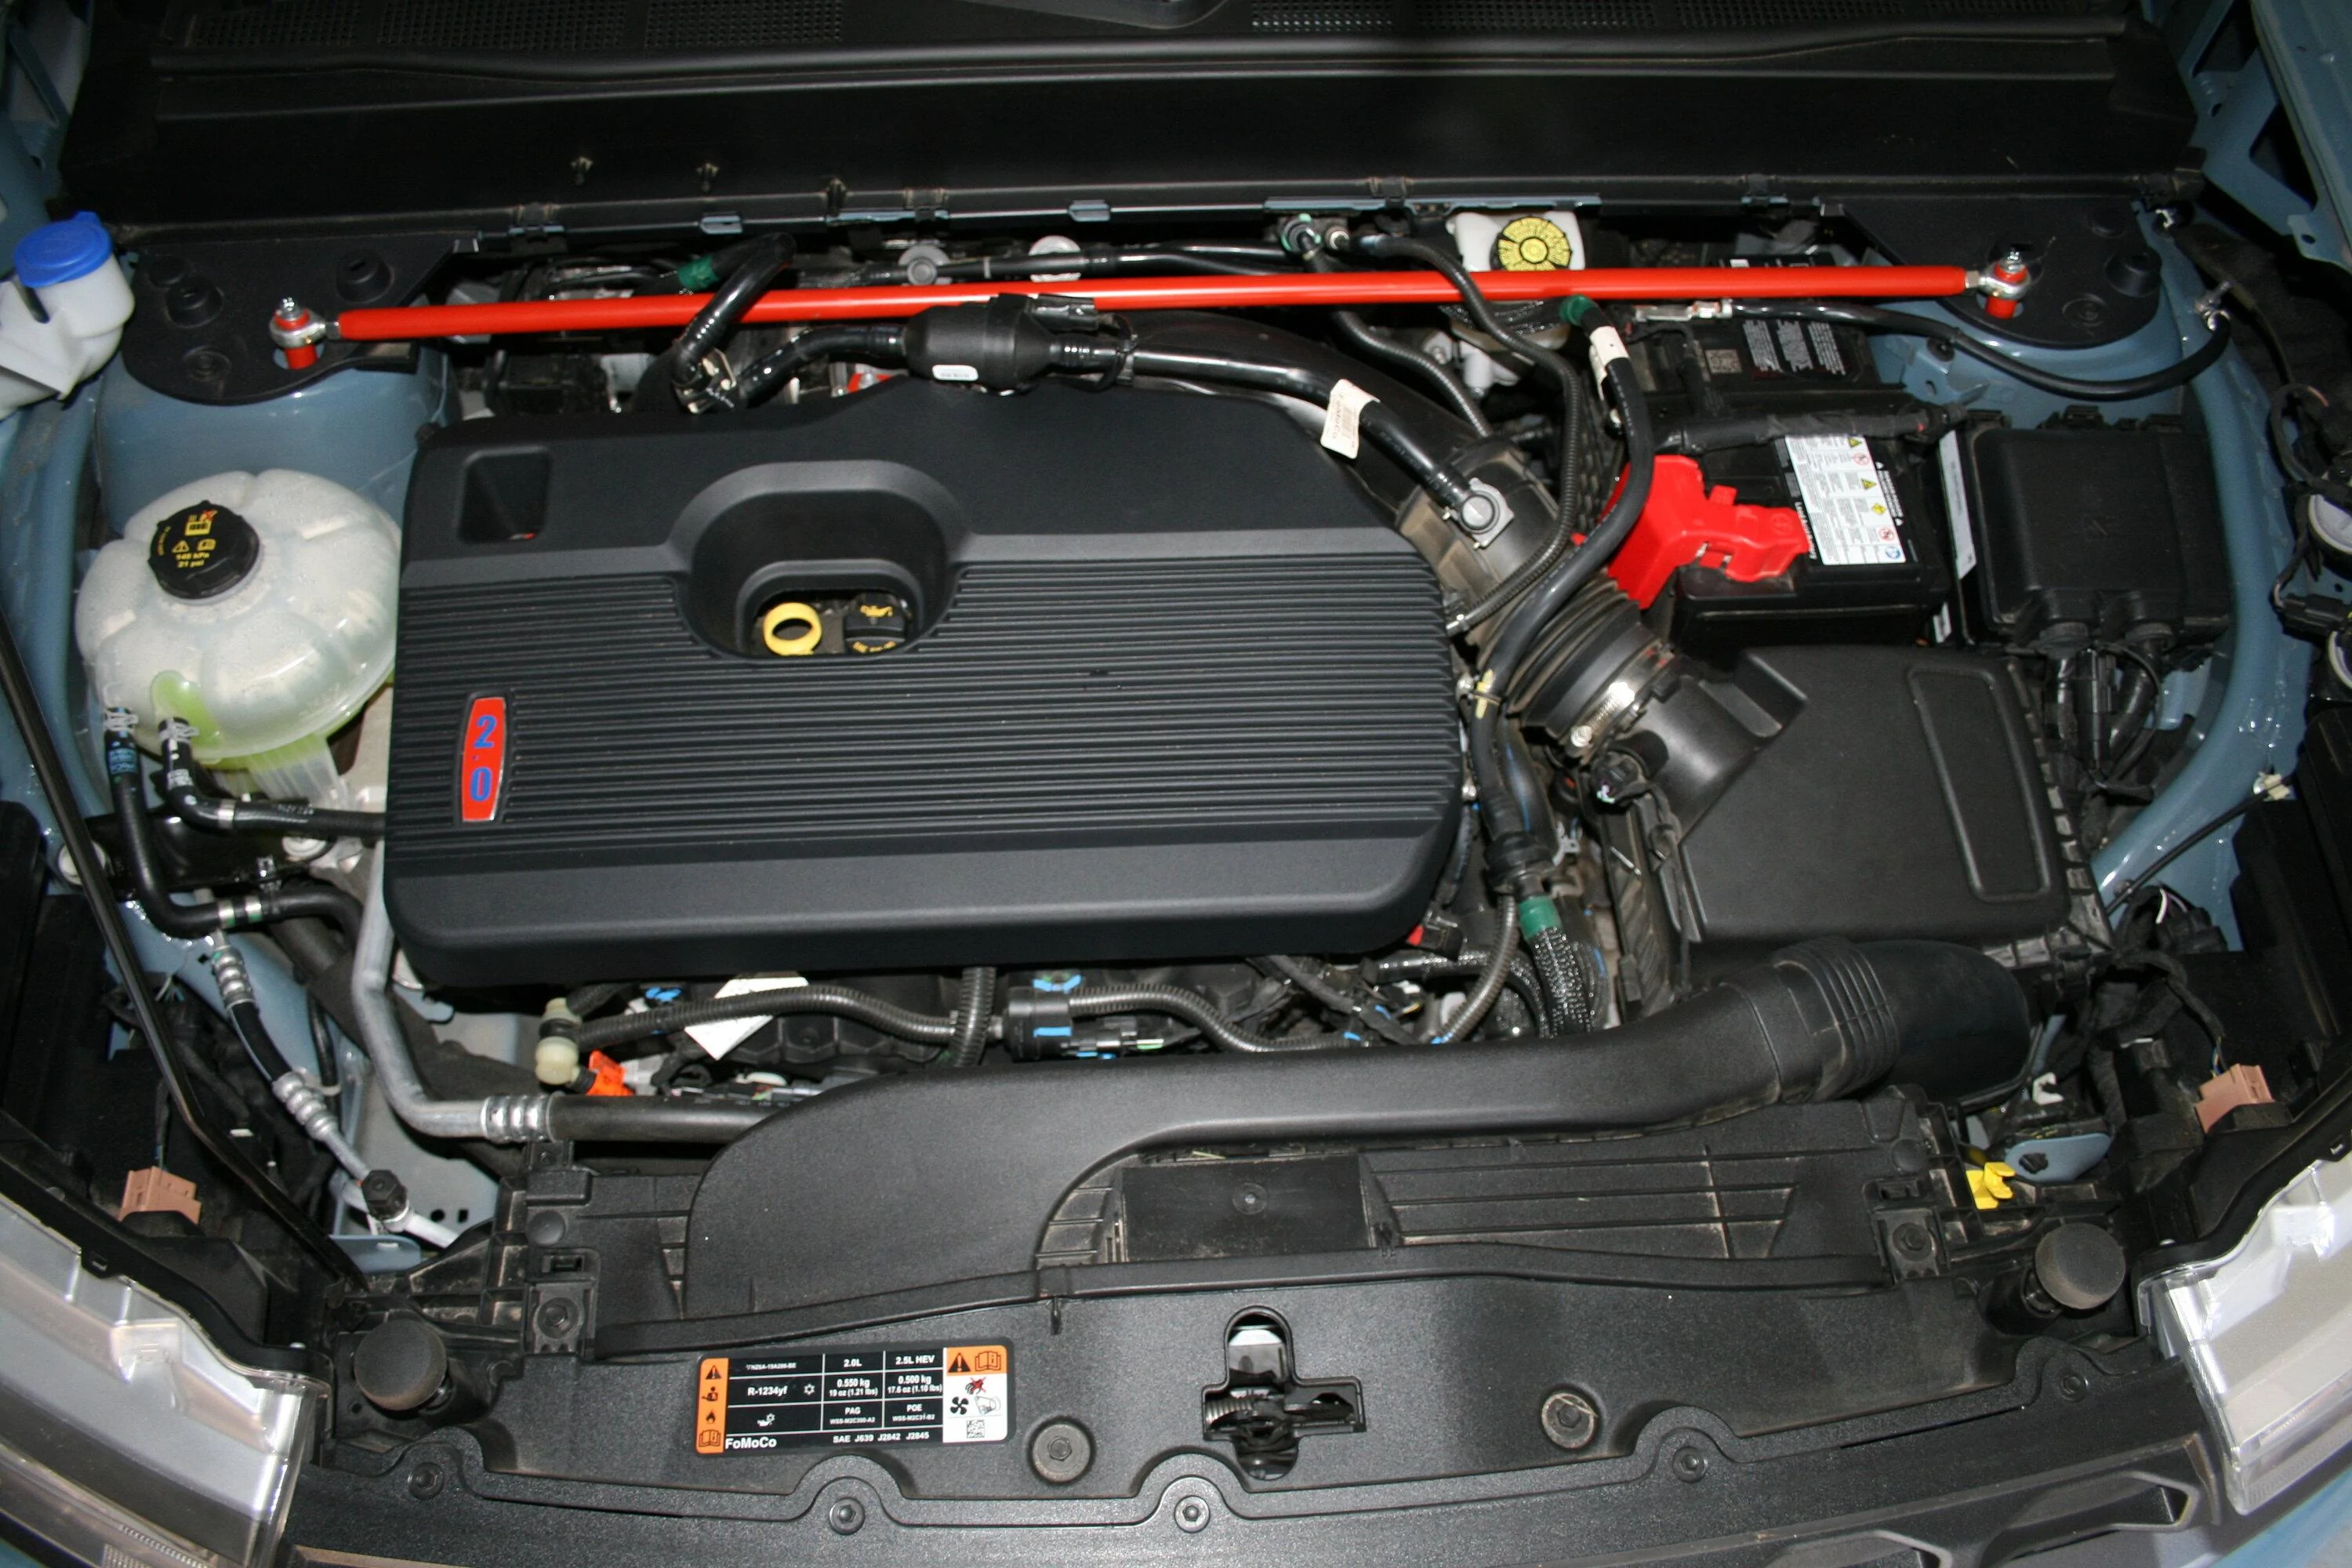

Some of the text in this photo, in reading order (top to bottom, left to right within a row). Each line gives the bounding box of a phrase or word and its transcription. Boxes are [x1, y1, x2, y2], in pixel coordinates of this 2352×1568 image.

[844, 1359, 862, 1367] 2.0L
[895, 1355, 935, 1365] 2.5L HEV
[837, 1378, 870, 1388] 0.550 kg
[898, 1374, 932, 1385] 0.500 kg
[747, 1385, 788, 1397] R-1234yf
[848, 1388, 864, 1397] (1.21
[865, 1388, 878, 1396] lbs)
[912, 1385, 928, 1394] (1.10
[929, 1385, 943, 1393] lbs)
[844, 1406, 861, 1415] PAG
[906, 1403, 923, 1412] POE
[855, 1434, 874, 1443] J639
[877, 1433, 901, 1442] J2842
[906, 1432, 930, 1440] J2845
[725, 1436, 777, 1450] FoMoCo
